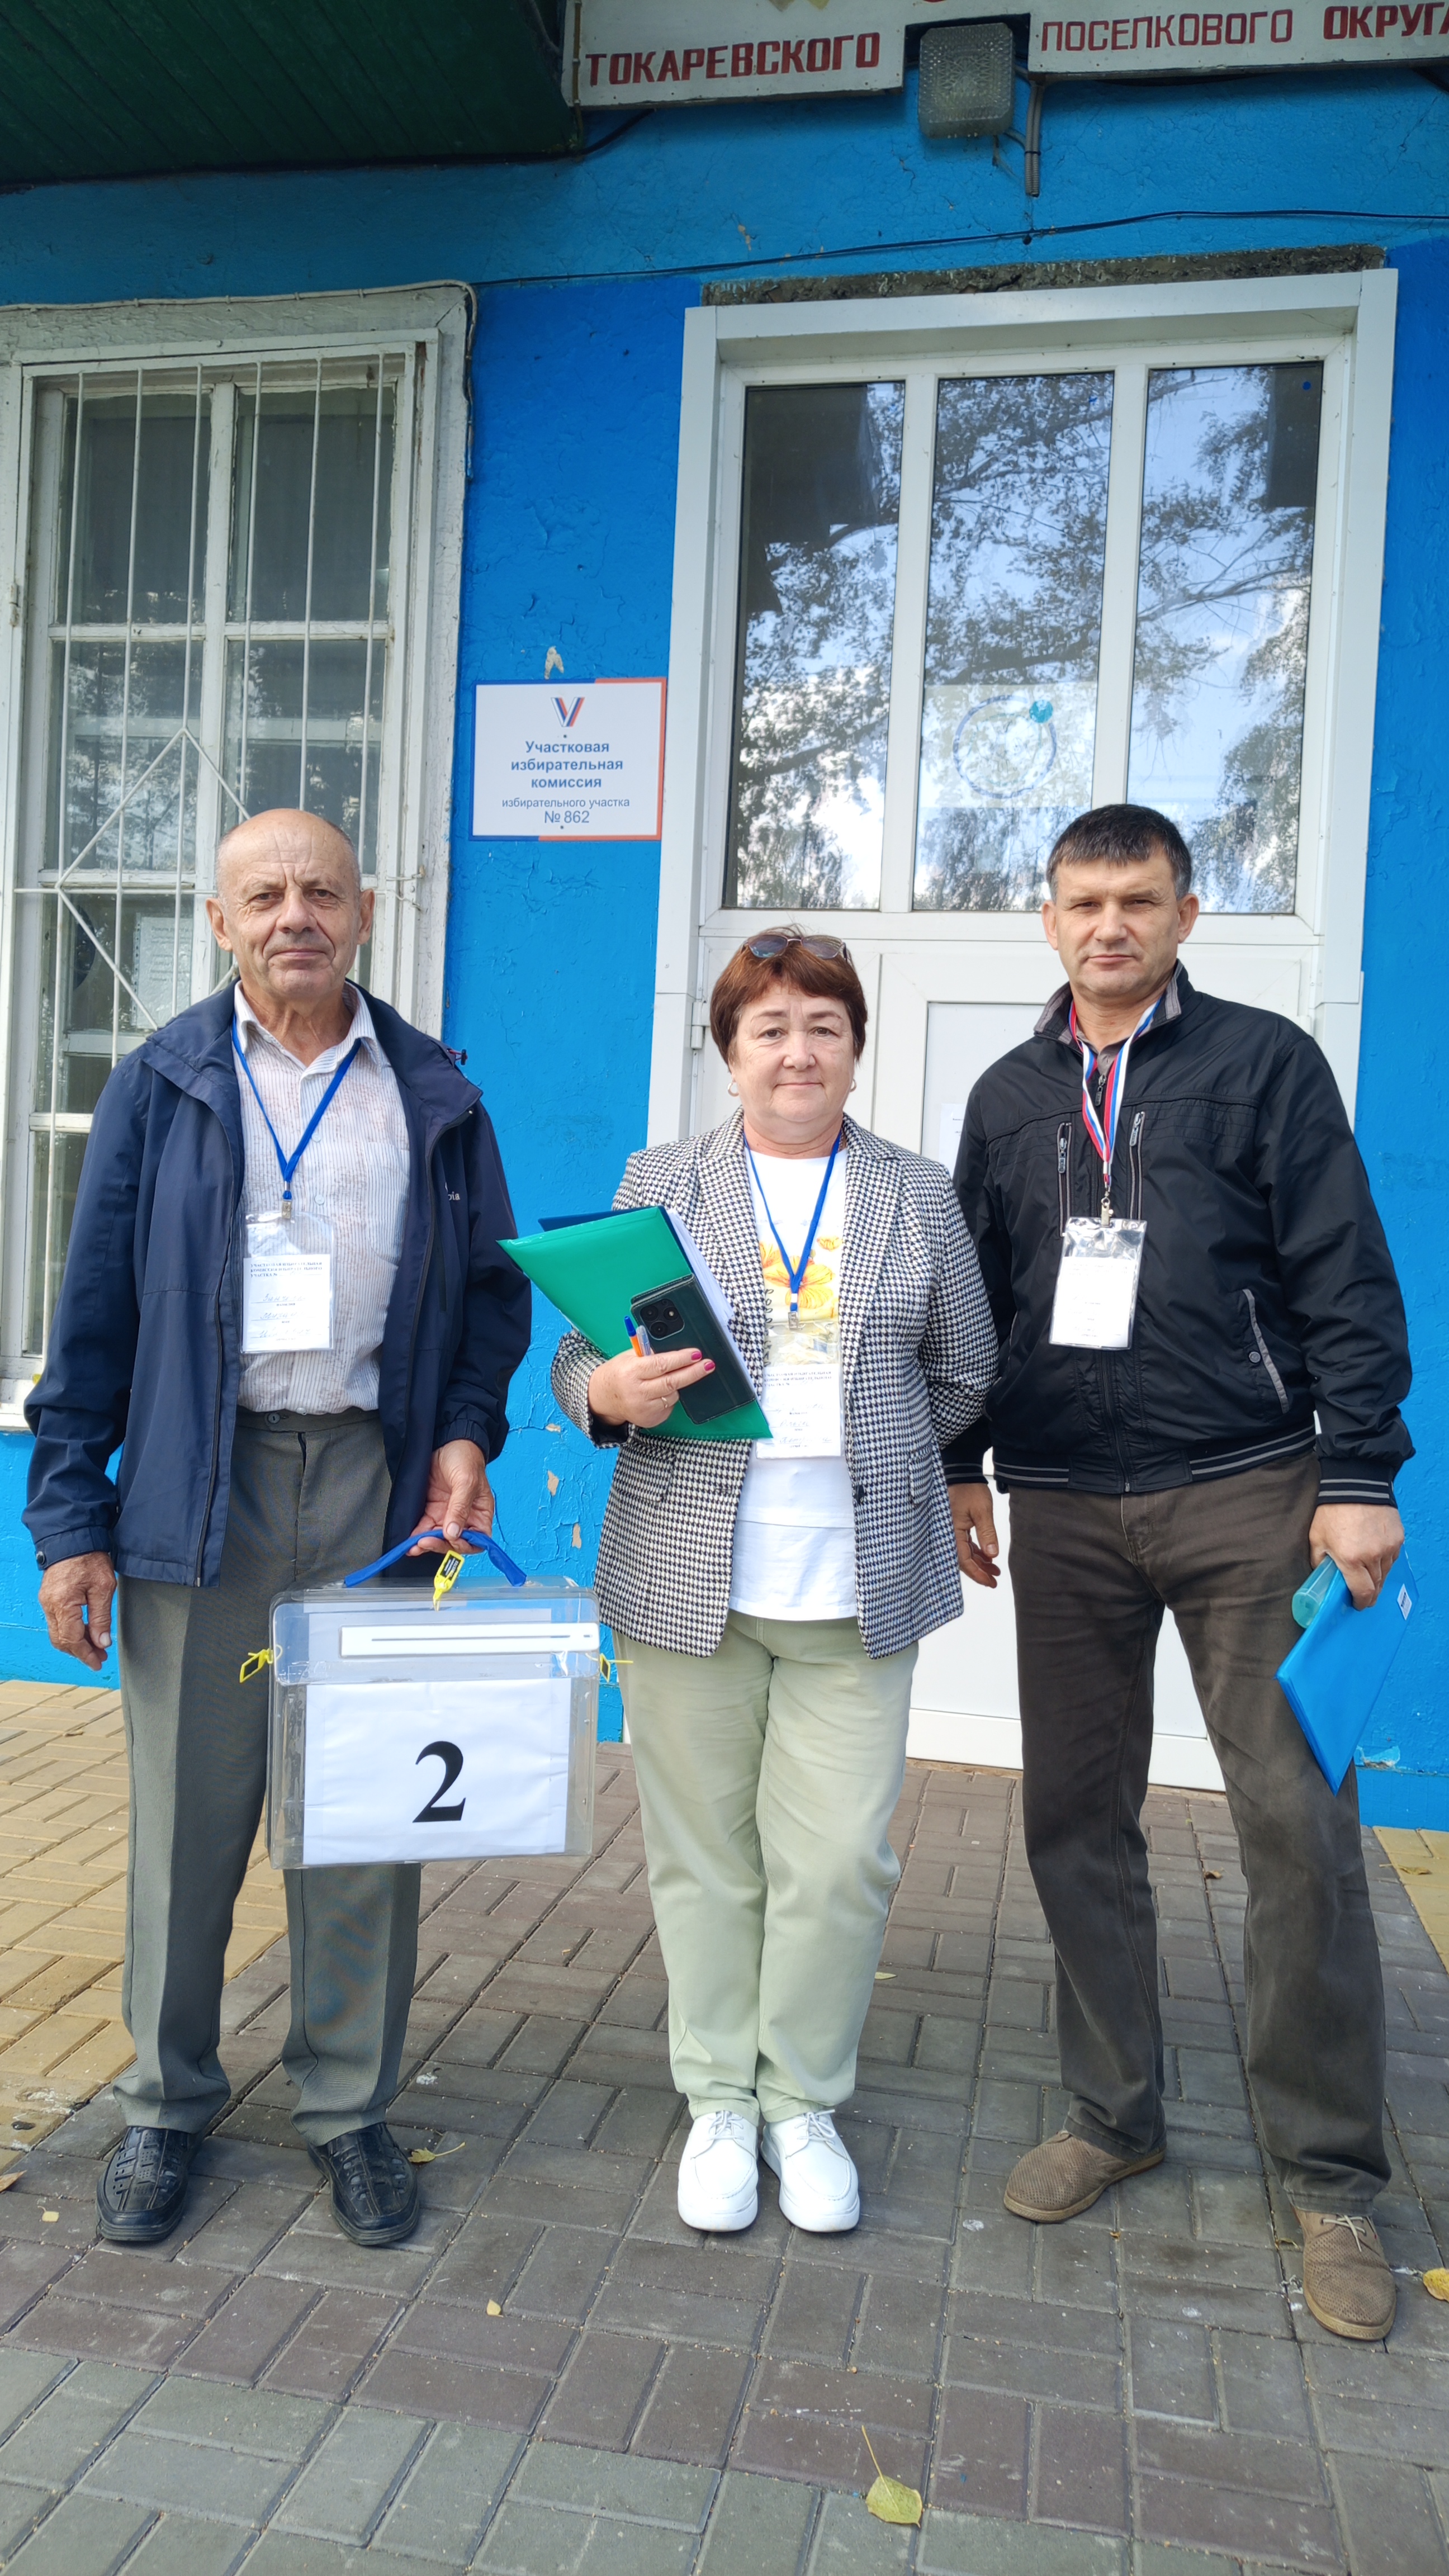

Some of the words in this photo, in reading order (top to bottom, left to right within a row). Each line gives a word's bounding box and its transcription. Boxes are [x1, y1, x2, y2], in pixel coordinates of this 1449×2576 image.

[1041, 9, 1293, 52] ПОСЕЛКОВОГО
[585, 32, 880, 87] ТОКАРЕВСКОГО
[525, 741, 610, 754] Участковая
[511, 758, 624, 774] избирательная
[531, 778, 602, 789] комиссия
[502, 797, 586, 809] избирательного
[589, 798, 630, 809] участка
[544, 811, 561, 823] №
[564, 811, 590, 824] 862
[413, 1740, 466, 1823] 2
